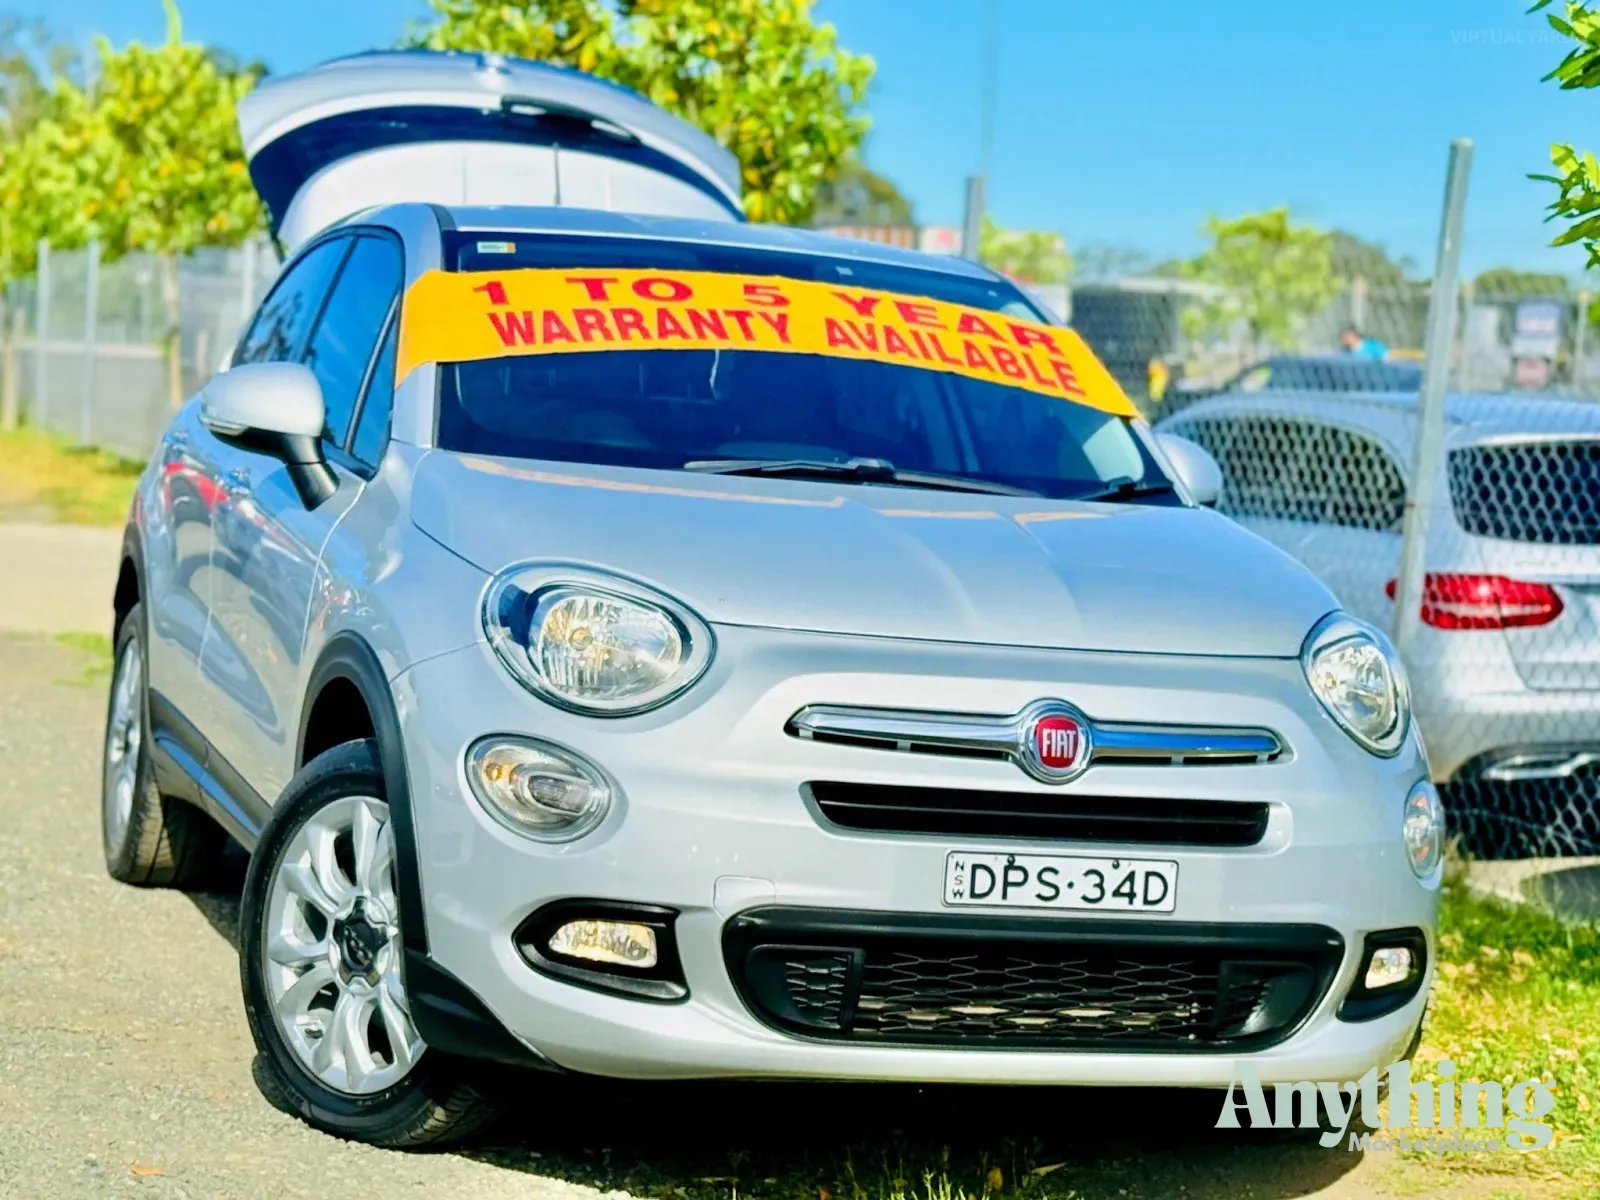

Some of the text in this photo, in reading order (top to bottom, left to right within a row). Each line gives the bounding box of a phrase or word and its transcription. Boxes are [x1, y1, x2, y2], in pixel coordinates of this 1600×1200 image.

[472, 276, 1065, 356] 1 TO 5 YEAR
[487, 307, 1086, 398] WARRANTY AVAILABLE
[1042, 728, 1077, 759] FIAT
